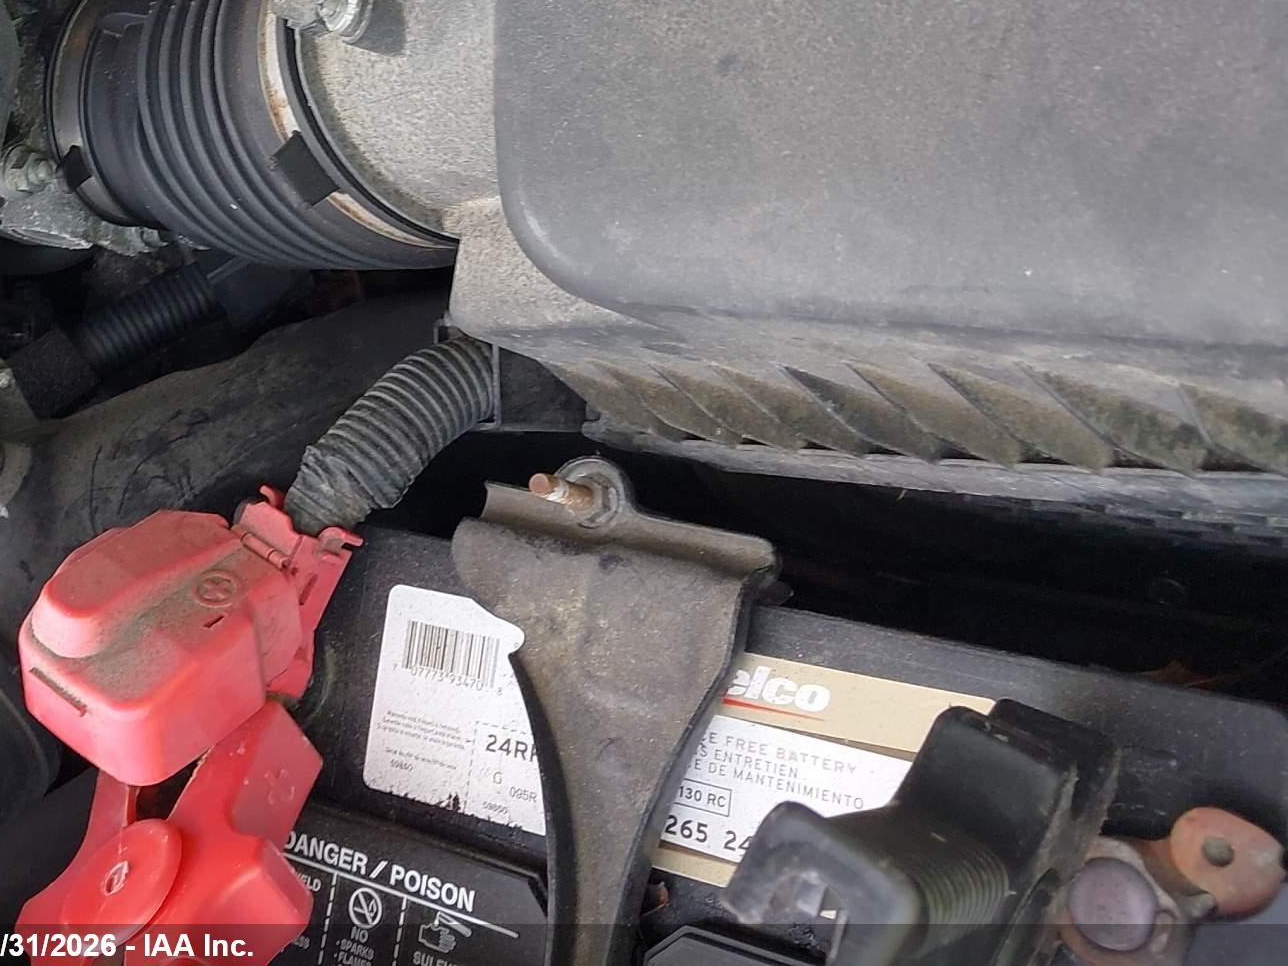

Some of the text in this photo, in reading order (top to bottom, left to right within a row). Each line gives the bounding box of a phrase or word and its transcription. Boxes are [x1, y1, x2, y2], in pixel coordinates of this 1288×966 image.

[727, 665, 831, 712] elco
[714, 749, 799, 778] ENTRETIEN
[725, 735, 770, 756] FREE
[776, 747, 858, 775] BATTERY
[679, 785, 727, 808] 130 RC
[708, 762, 727, 776] DE
[733, 767, 864, 810] MANTENIMIENTO
[664, 814, 708, 843] 265
[284, 831, 369, 876] DANGER
[389, 864, 476, 913] POISON
[351, 926, 369, 943] NO
